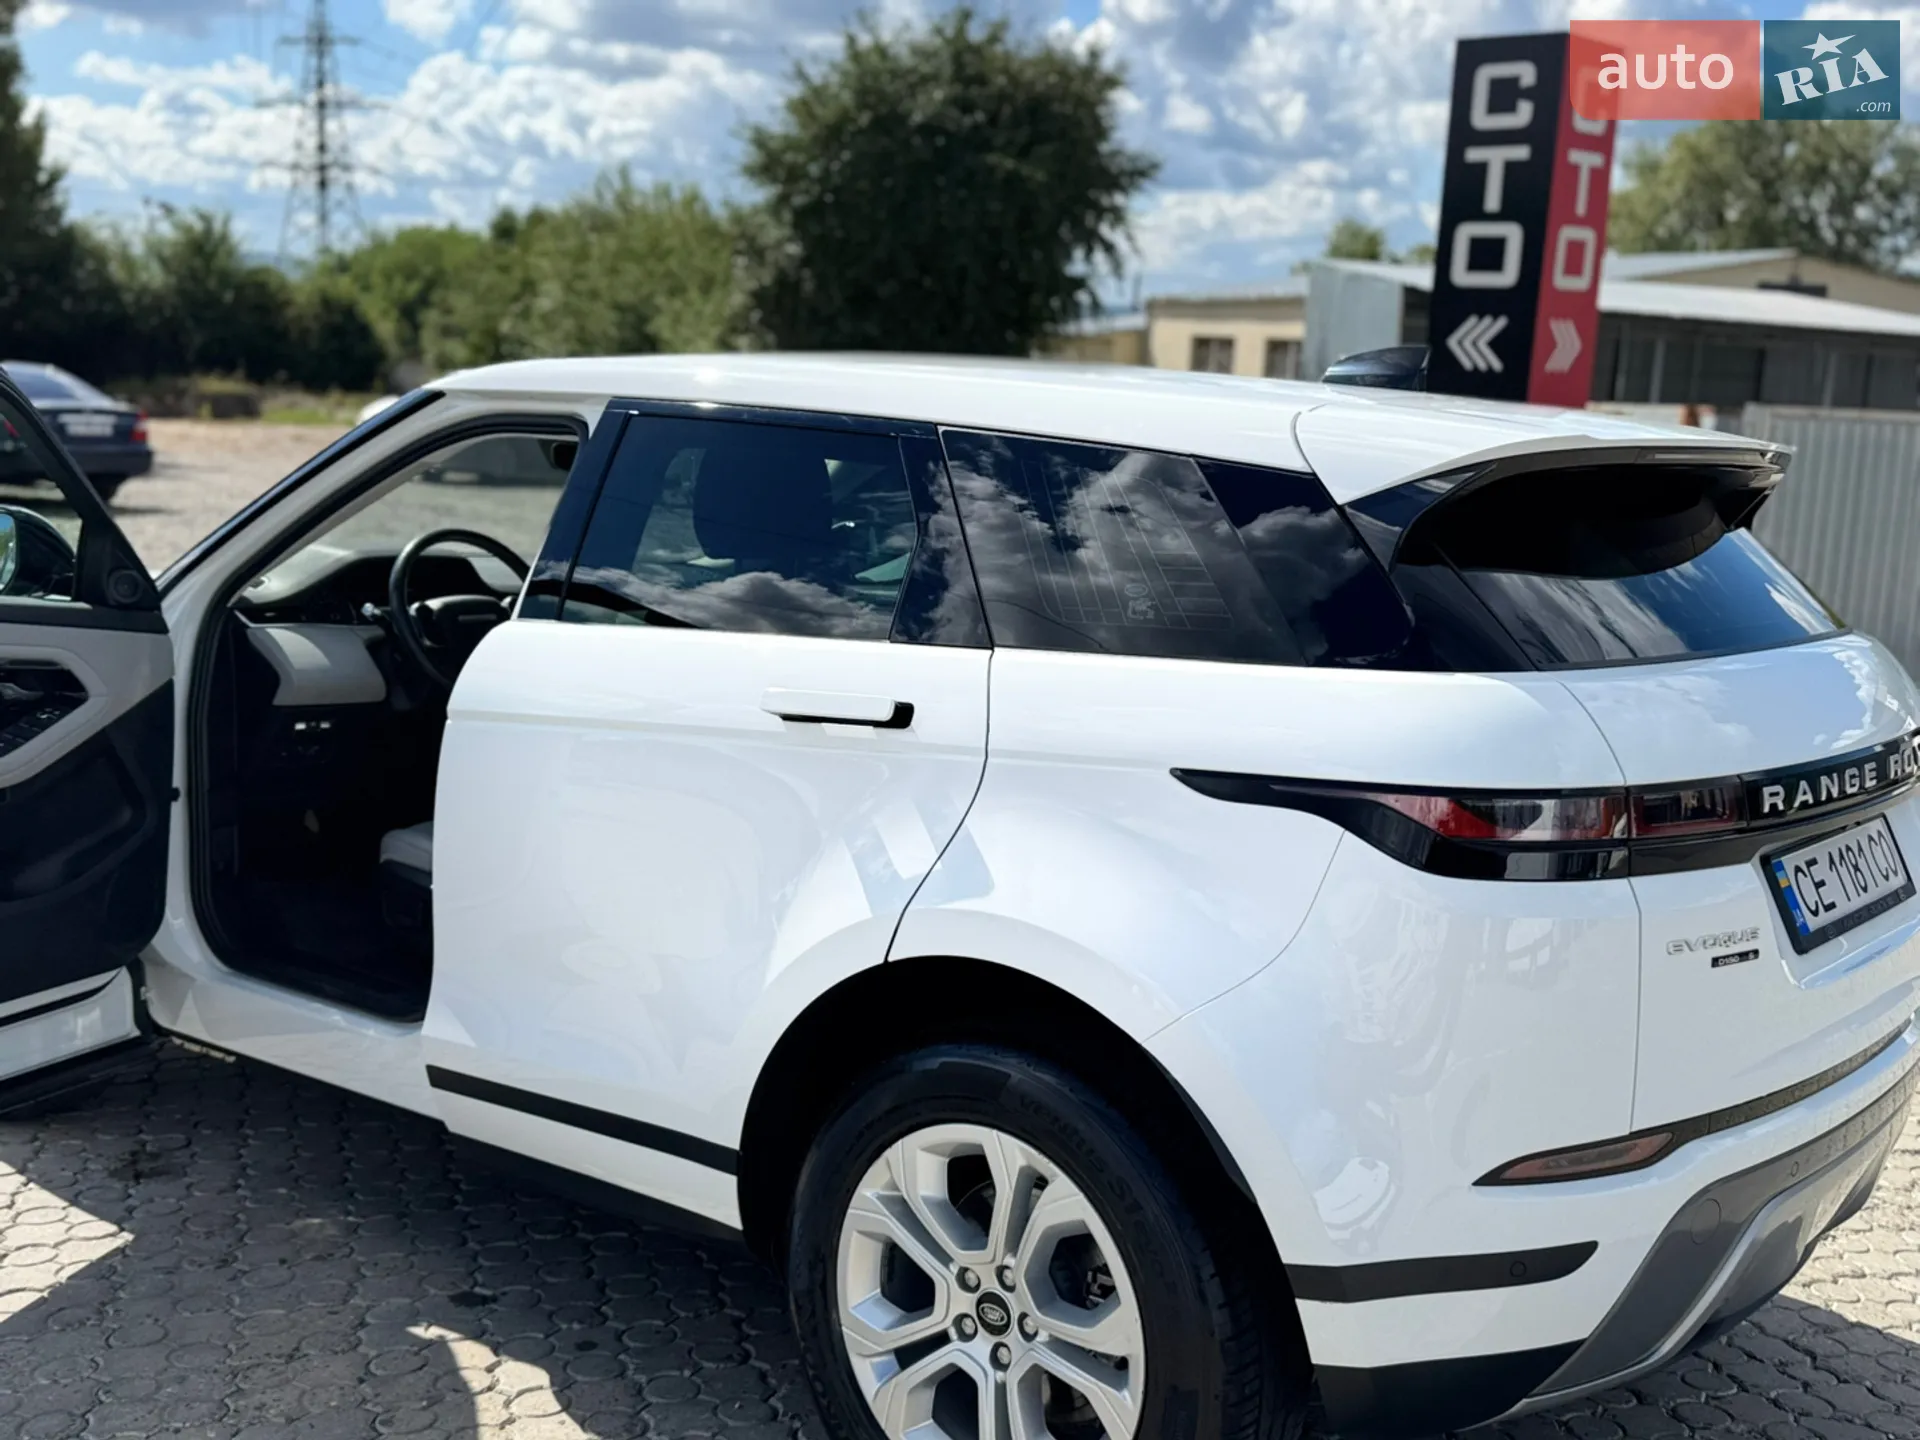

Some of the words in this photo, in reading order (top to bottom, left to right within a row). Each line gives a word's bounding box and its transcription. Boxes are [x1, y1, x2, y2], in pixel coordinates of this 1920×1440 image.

[1762, 761, 1878, 814] RANGE
[1794, 856, 1838, 918] CE
[1828, 838, 1879, 903] 1181
[1666, 926, 1760, 956] EVOQUE
